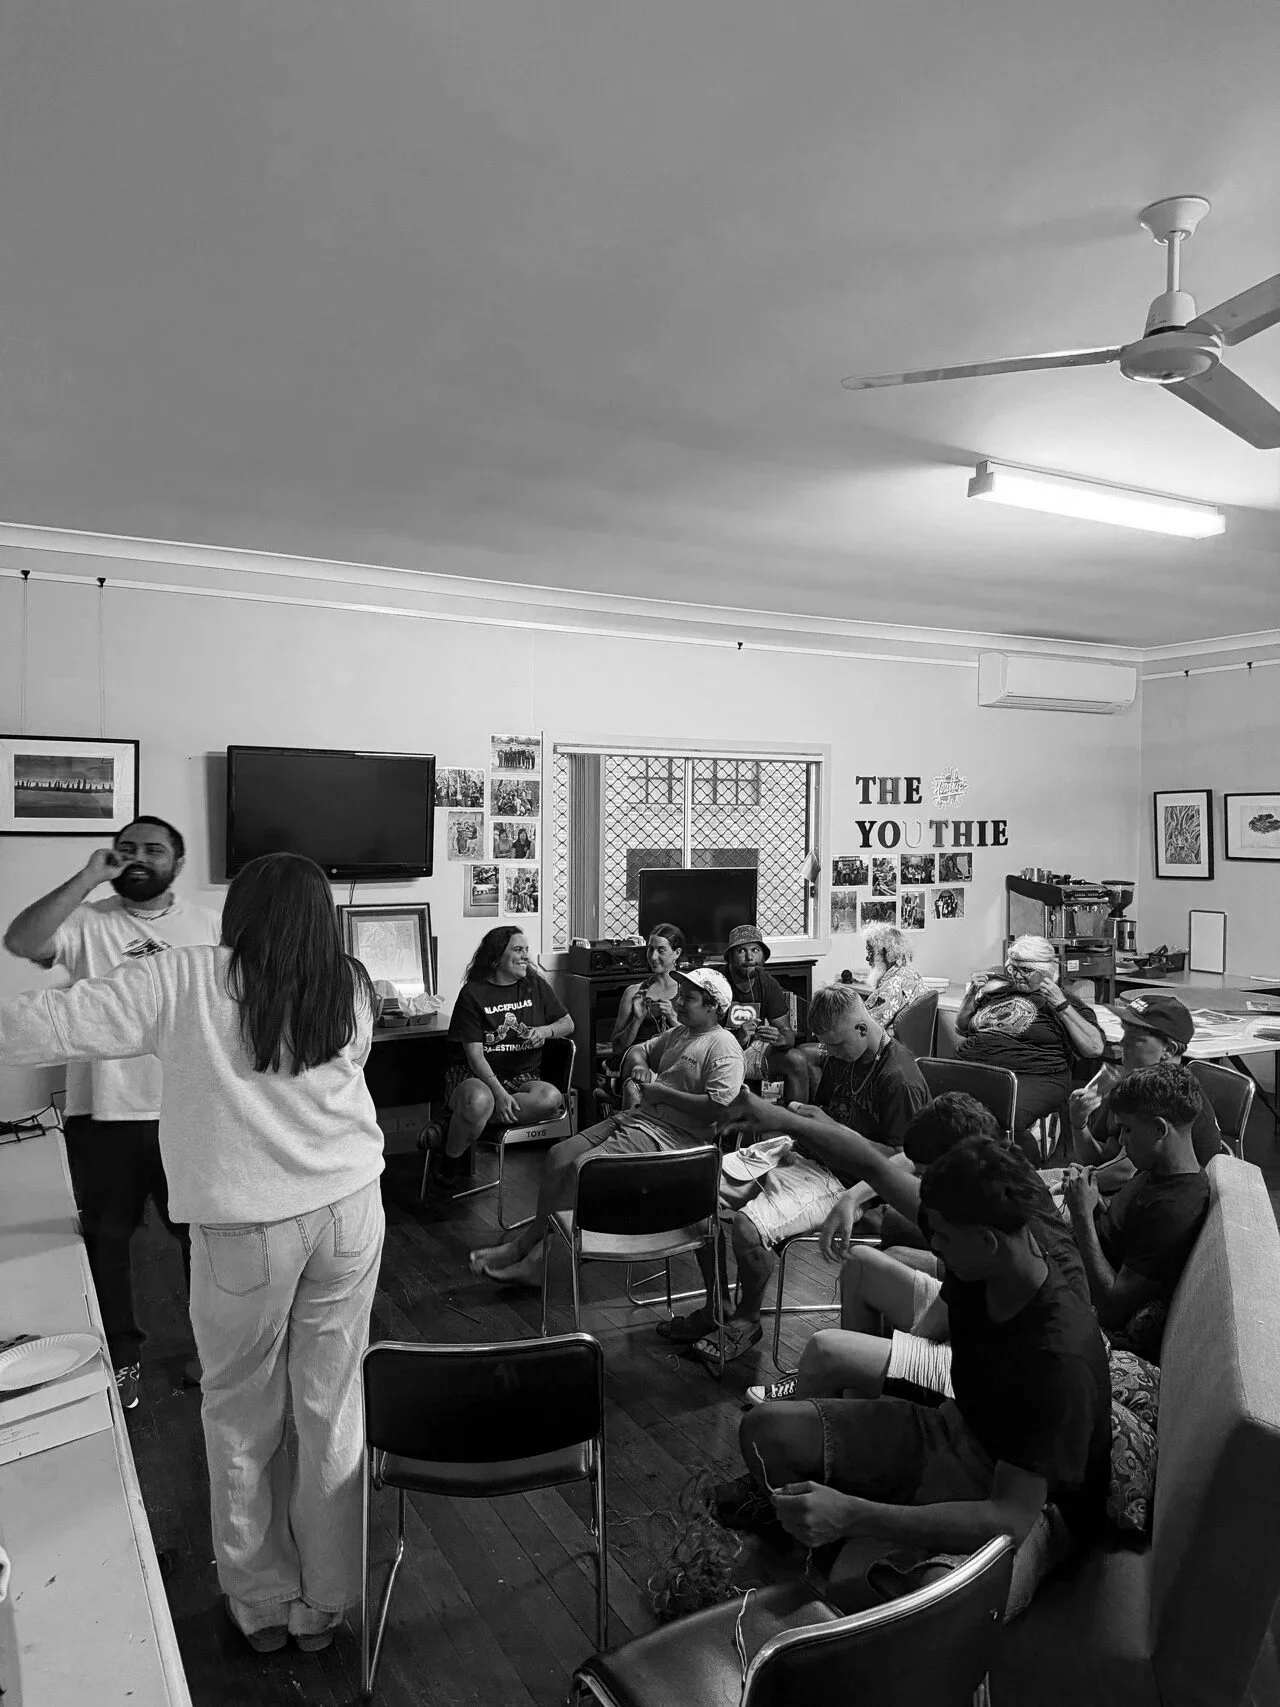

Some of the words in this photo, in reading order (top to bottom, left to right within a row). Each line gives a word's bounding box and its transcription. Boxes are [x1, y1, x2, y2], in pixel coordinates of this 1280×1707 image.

[855, 776, 922, 804] THE
[855, 820, 1008, 848] YOUTHIE
[484, 999, 533, 1014] BLACKFULLAS
[483, 1043, 533, 1053] PAESTINIAN
[526, 1130, 547, 1138] TOYS
